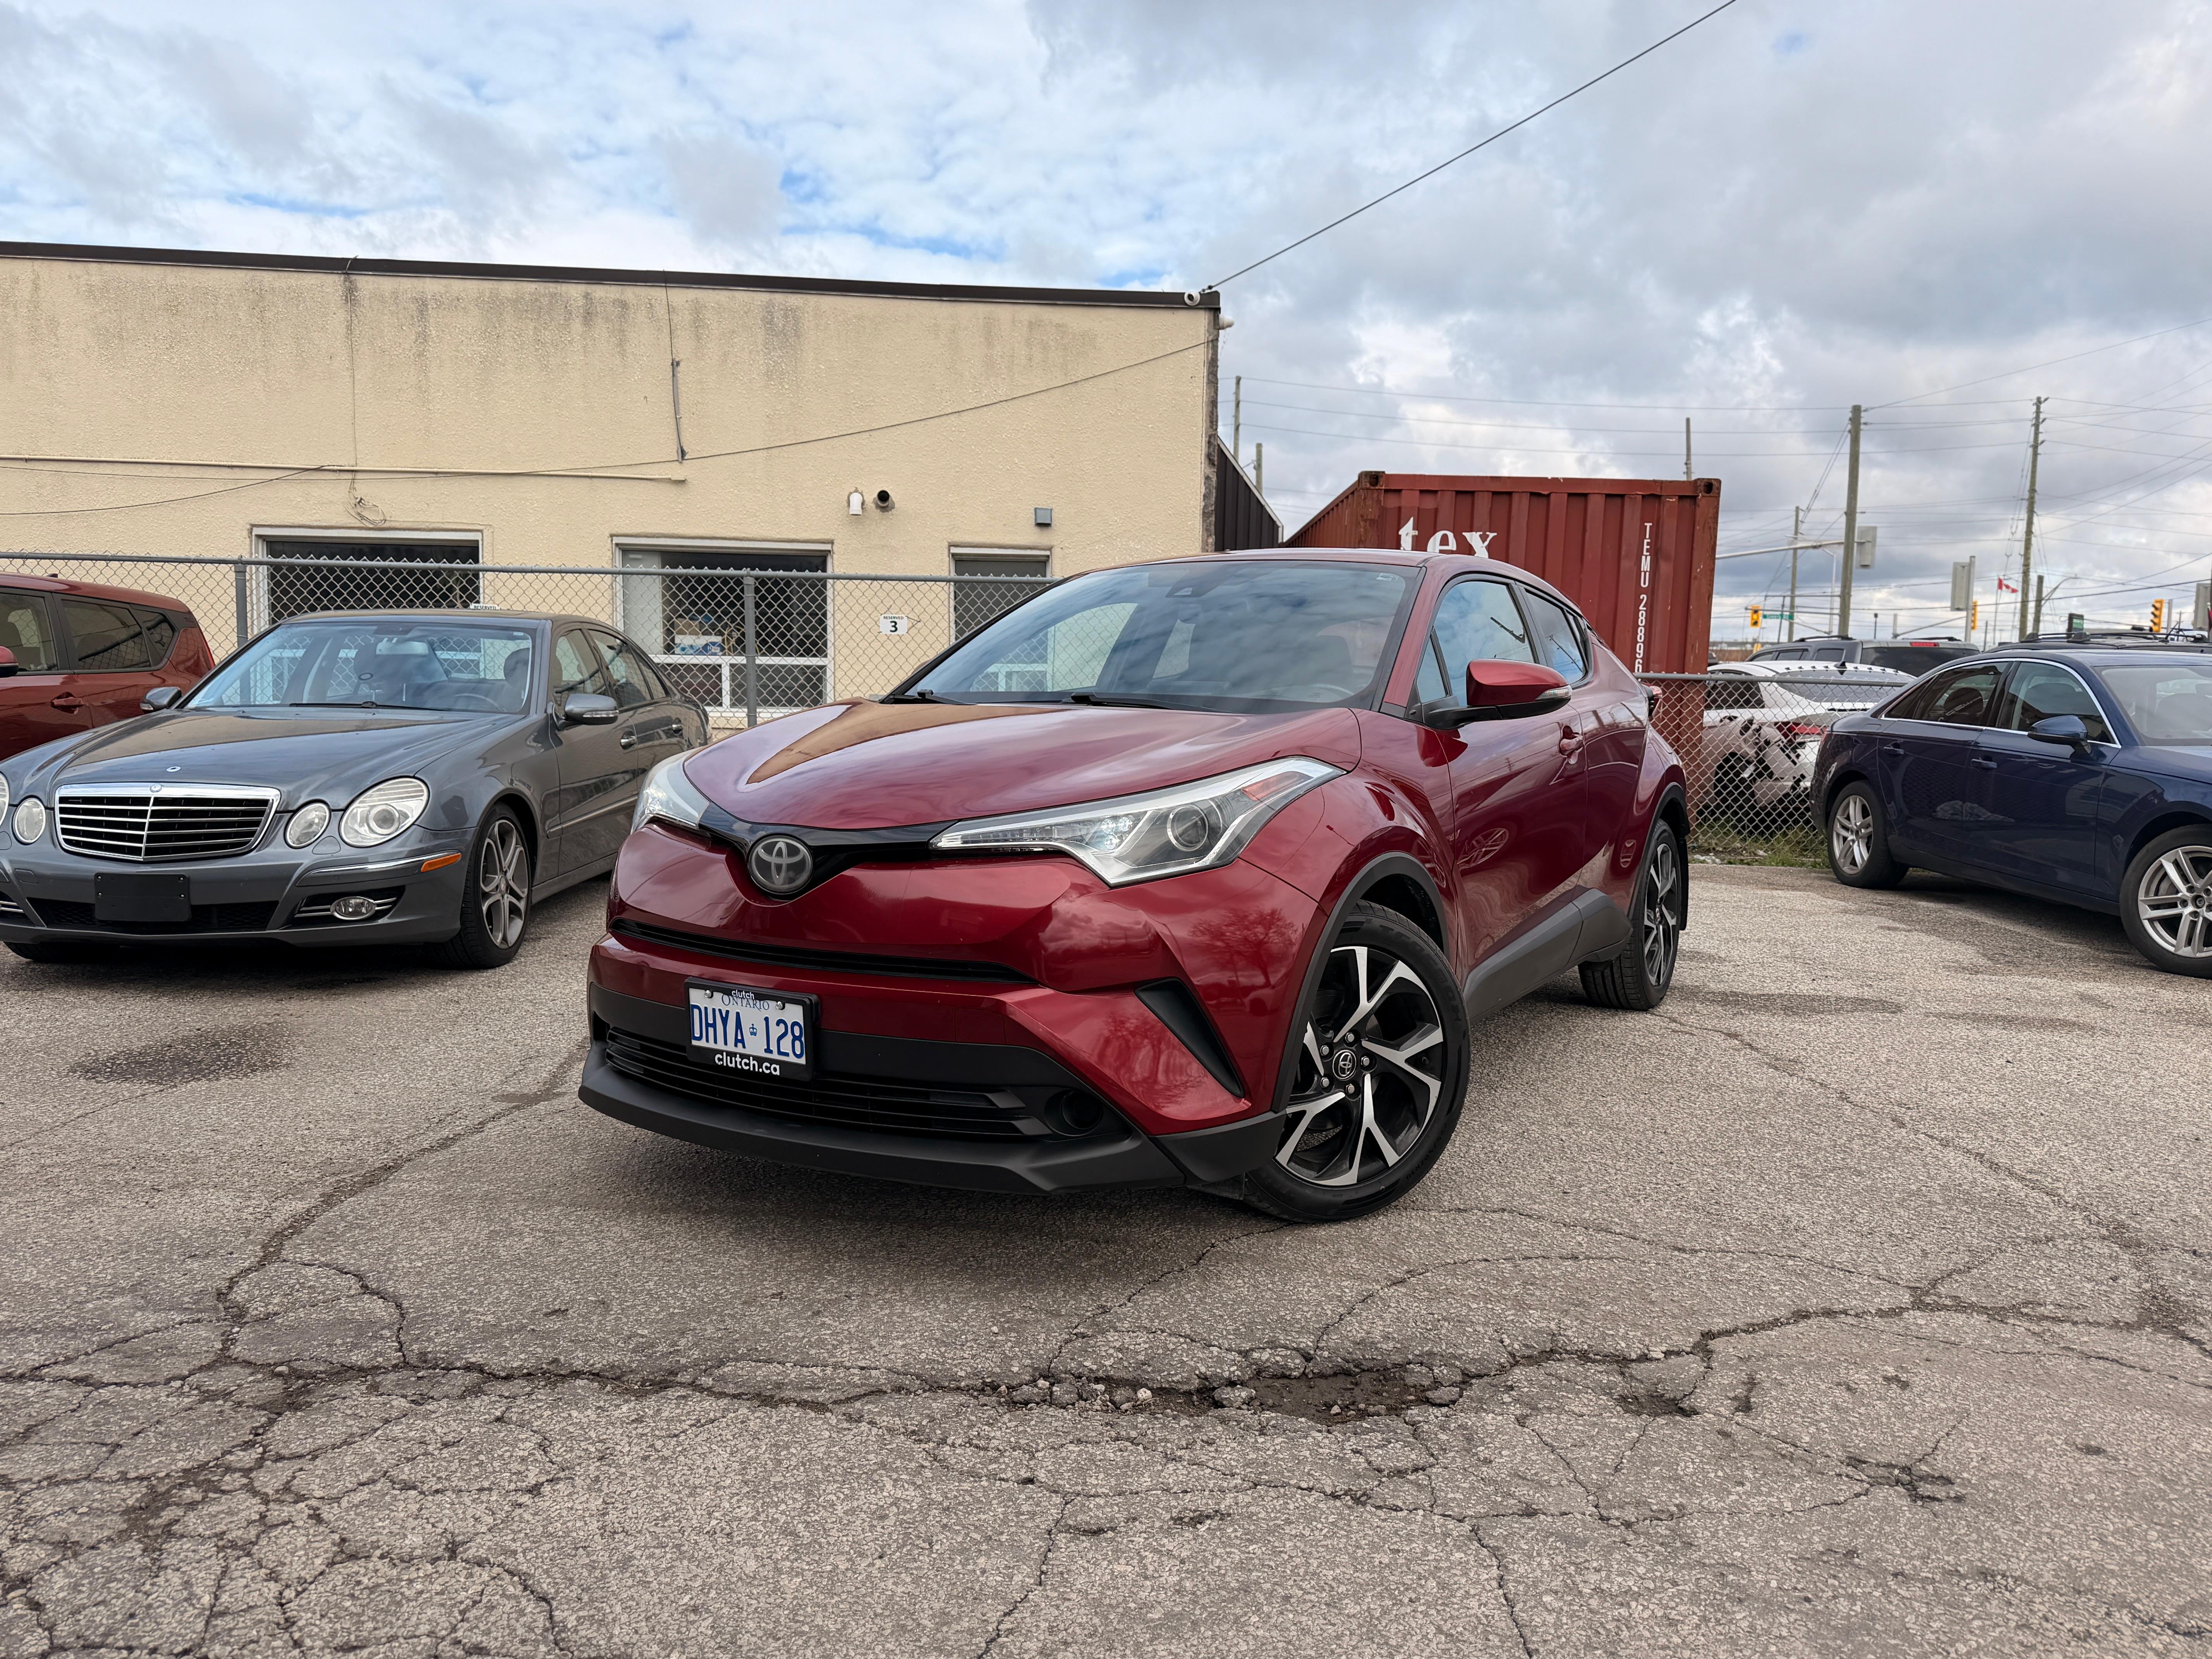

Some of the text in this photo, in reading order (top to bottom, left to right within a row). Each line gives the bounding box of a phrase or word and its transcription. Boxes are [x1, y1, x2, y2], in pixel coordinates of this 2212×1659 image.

[1635, 523, 1652, 682] TEMU 28896
[890, 620, 898, 632] 3
[721, 994, 769, 1012] ONTARIO
[732, 989, 755, 1000] clutch
[690, 1004, 804, 1059] DHYA 128
[715, 1052, 780, 1076] clutch.ca
